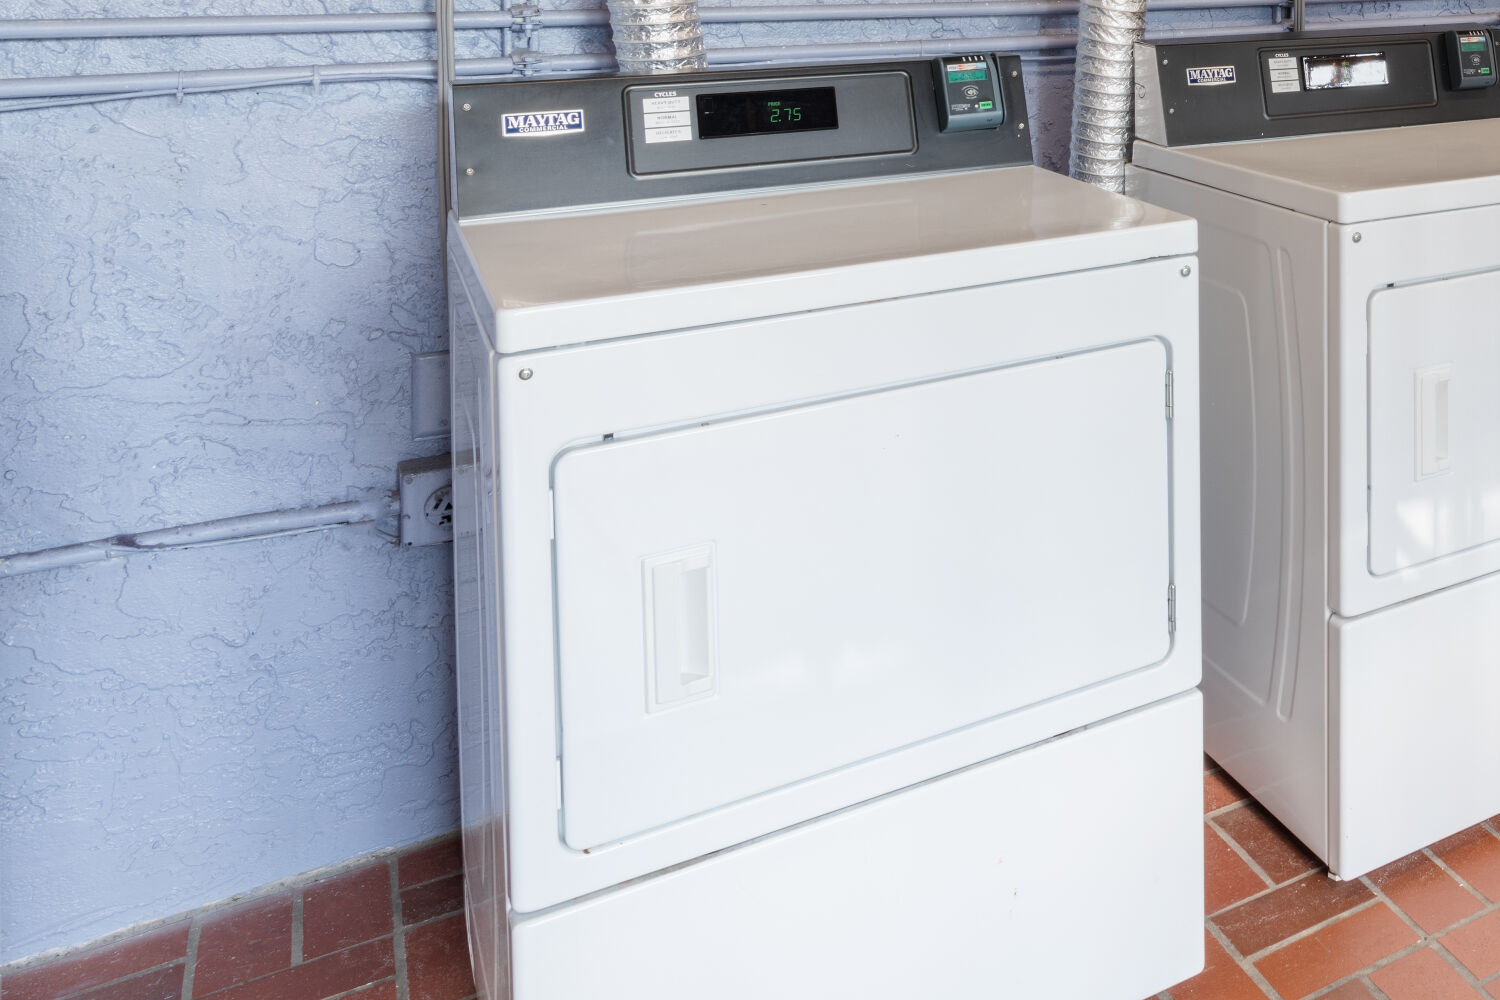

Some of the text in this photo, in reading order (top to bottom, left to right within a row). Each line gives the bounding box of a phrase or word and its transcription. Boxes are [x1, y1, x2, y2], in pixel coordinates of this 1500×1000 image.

[1190, 68, 1233, 79] MAYTAG
[507, 112, 580, 129] MAYTAG
[770, 107, 802, 123] 2.75
[519, 124, 568, 133] COMMERCIAL
